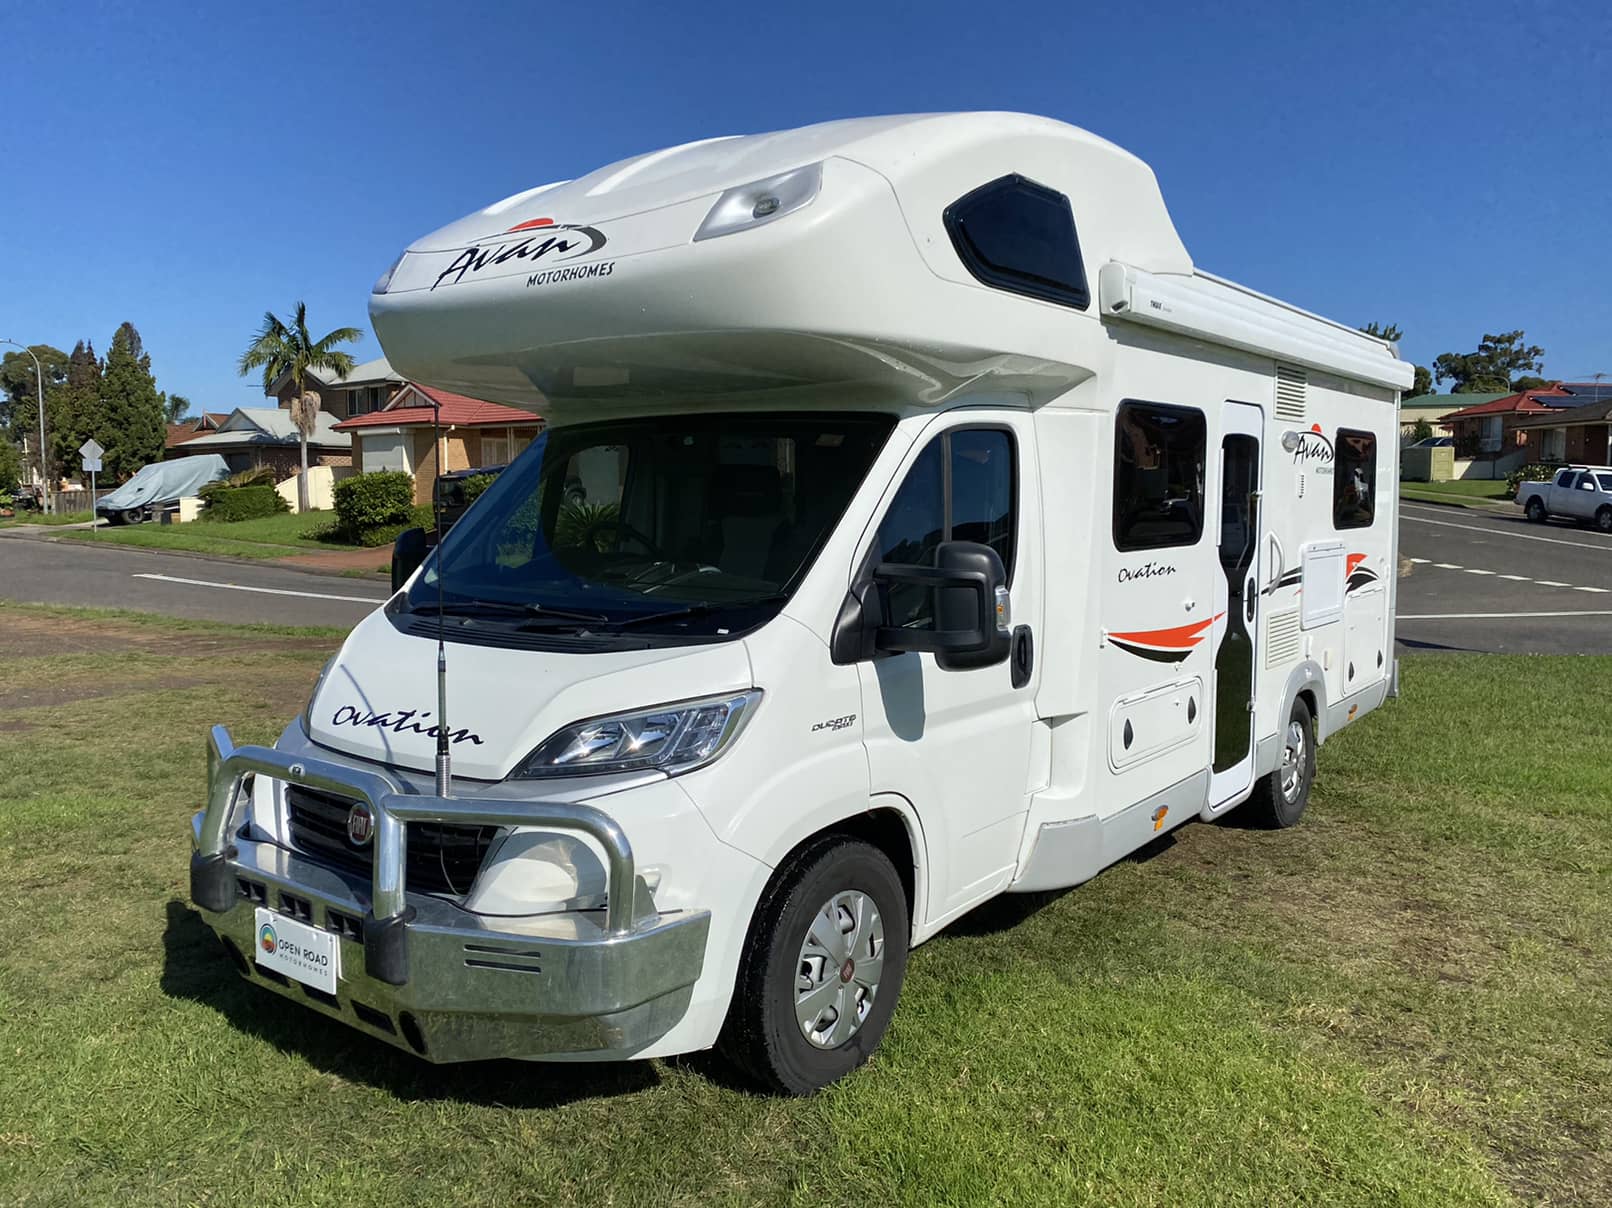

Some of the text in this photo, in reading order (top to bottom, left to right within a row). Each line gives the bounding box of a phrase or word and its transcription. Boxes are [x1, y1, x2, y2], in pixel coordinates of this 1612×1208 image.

[430, 237, 580, 291] Avan
[526, 262, 616, 288] MOTORHOMES
[1293, 434, 1331, 464] Avan
[1118, 562, 1176, 583] Ovation
[279, 939, 328, 966] OPEN ROAD
